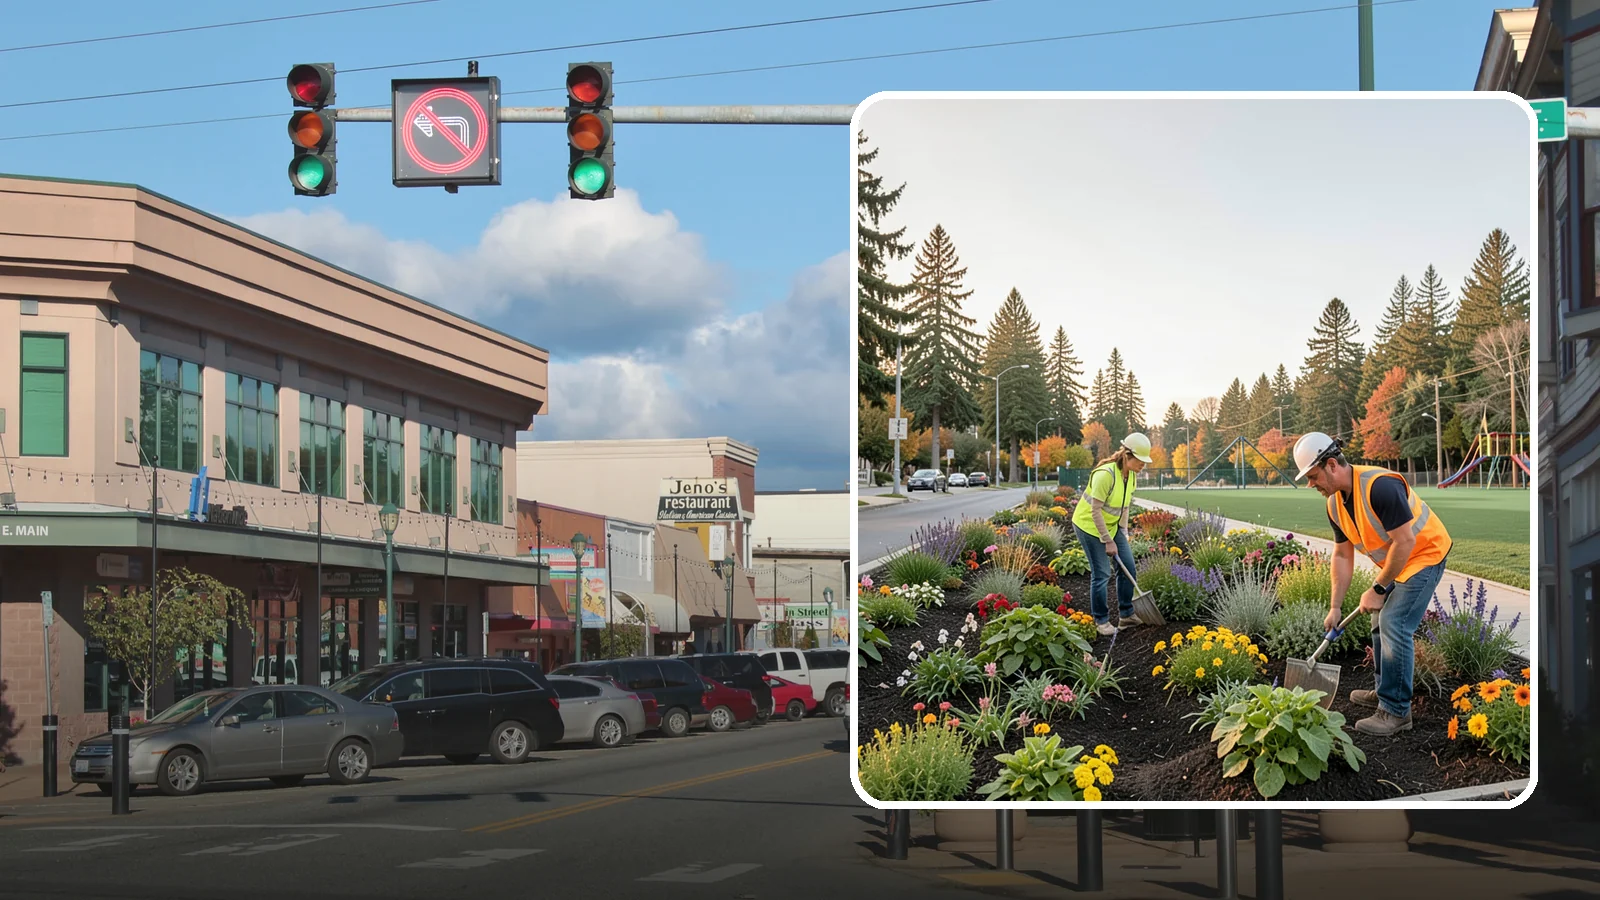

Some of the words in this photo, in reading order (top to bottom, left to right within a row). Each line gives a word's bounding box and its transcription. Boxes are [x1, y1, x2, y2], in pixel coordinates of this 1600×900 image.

[669, 479, 727, 494] Jeno's
[665, 497, 731, 509] restaurant
[658, 510, 681, 519] Italian
[686, 510, 714, 519] American
[715, 510, 737, 519] Cuisine
[2, 525, 13, 536] E.
[15, 525, 49, 536] MAIN
[785, 608, 795, 617] in
[797, 607, 828, 617] Street
